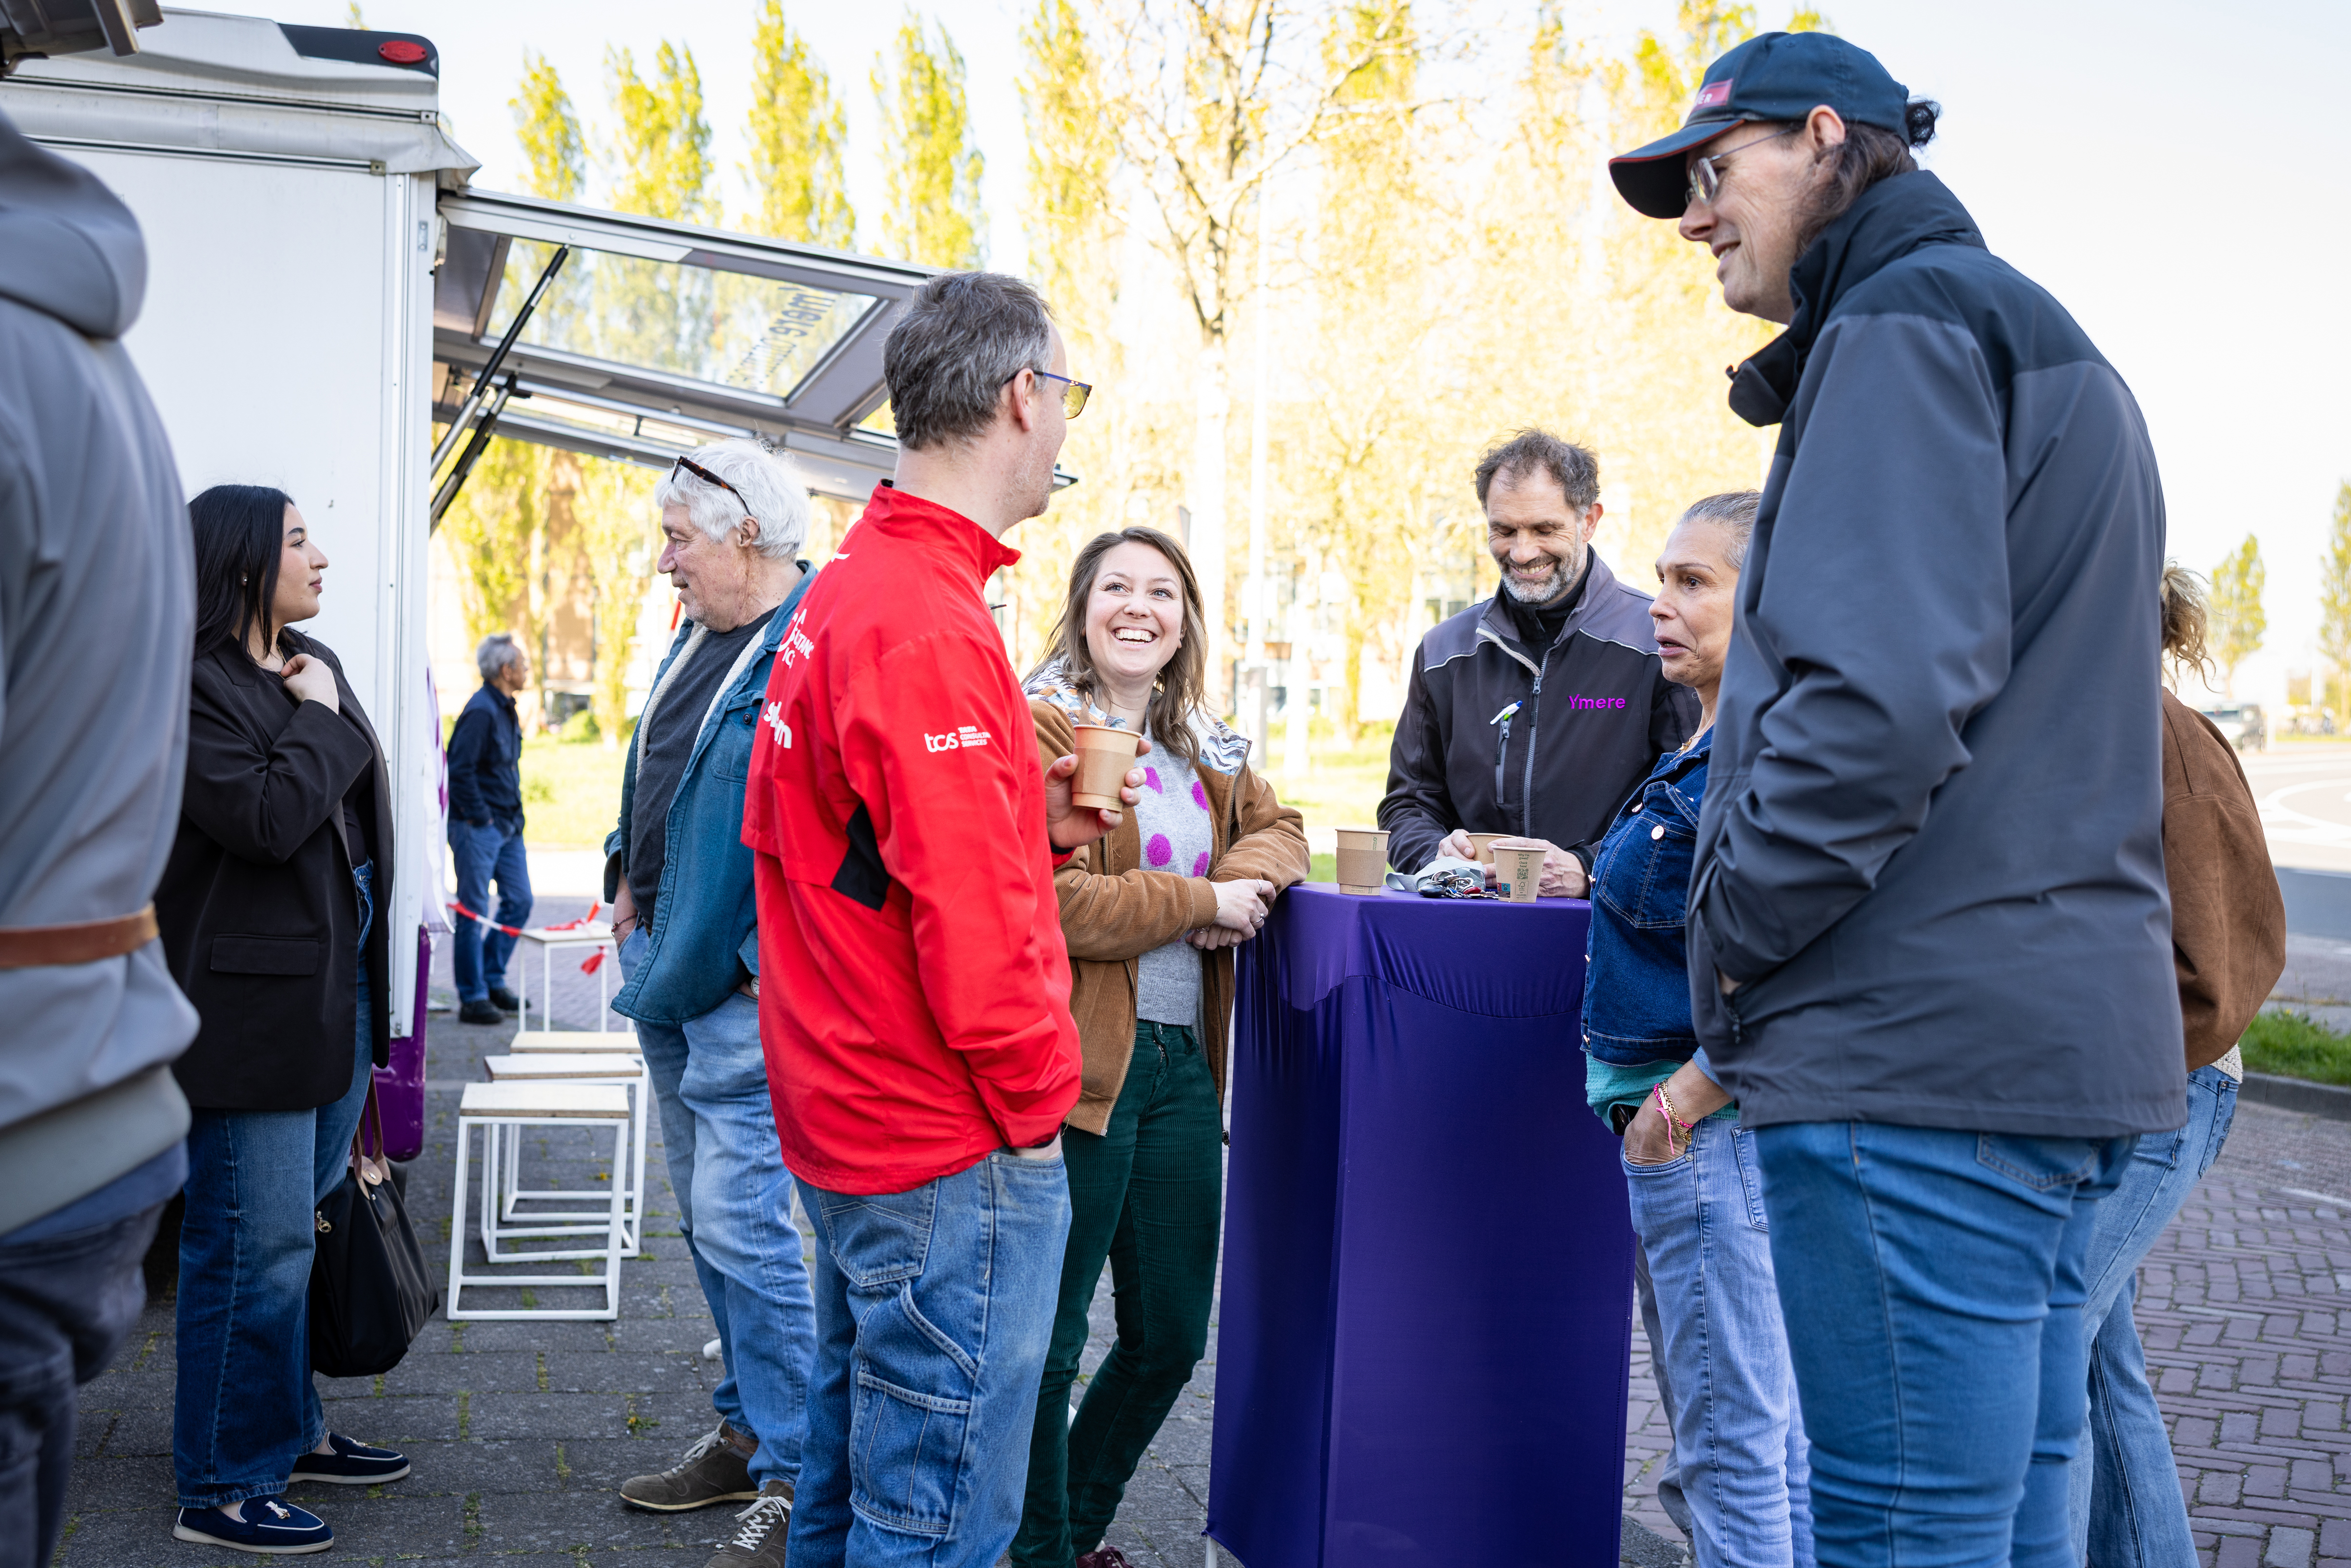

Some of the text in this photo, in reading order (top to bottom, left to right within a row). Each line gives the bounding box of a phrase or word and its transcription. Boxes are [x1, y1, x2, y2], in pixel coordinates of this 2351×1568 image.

[1568, 694, 1626, 709] Ymere
[960, 732, 991, 740] CONSULTA
[924, 732, 959, 753] tcs
[961, 738, 988, 747] SERVICES
